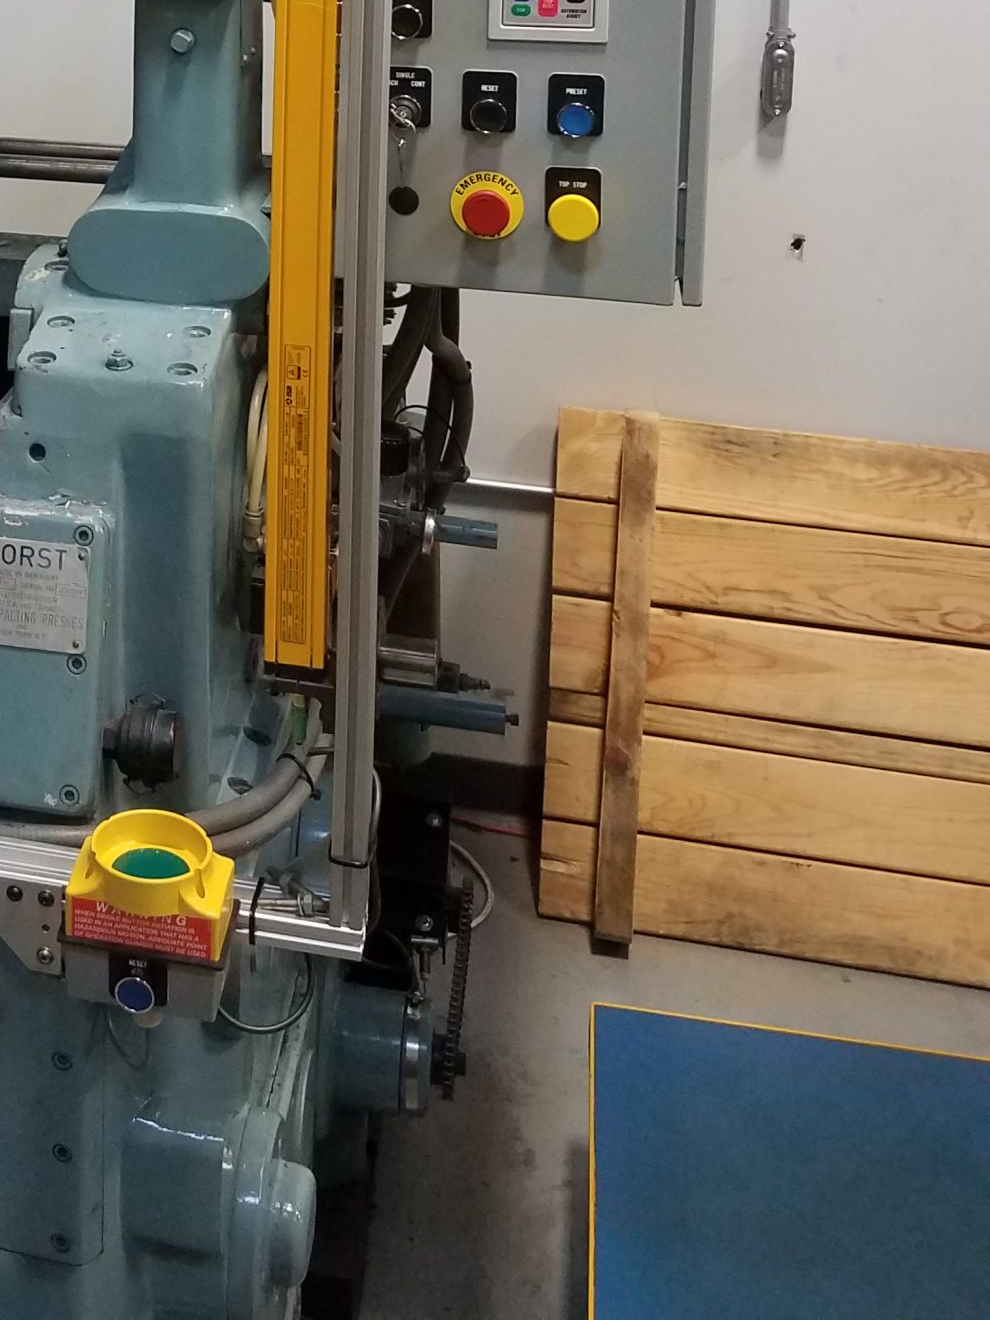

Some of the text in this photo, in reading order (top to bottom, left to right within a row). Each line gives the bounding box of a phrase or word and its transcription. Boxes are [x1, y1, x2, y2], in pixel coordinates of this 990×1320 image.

[410, 80, 426, 88] CONT
[481, 84, 499, 92] RESET
[565, 87, 587, 95] PRESET
[455, 173, 519, 196] EMERGENCY
[558, 180, 588, 189] TOP STOP
[42, 613, 83, 630] PRESSES
[113, 923, 158, 935] APPLICATION
[186, 941, 207, 950] POINT
[128, 959, 147, 968] RESET
